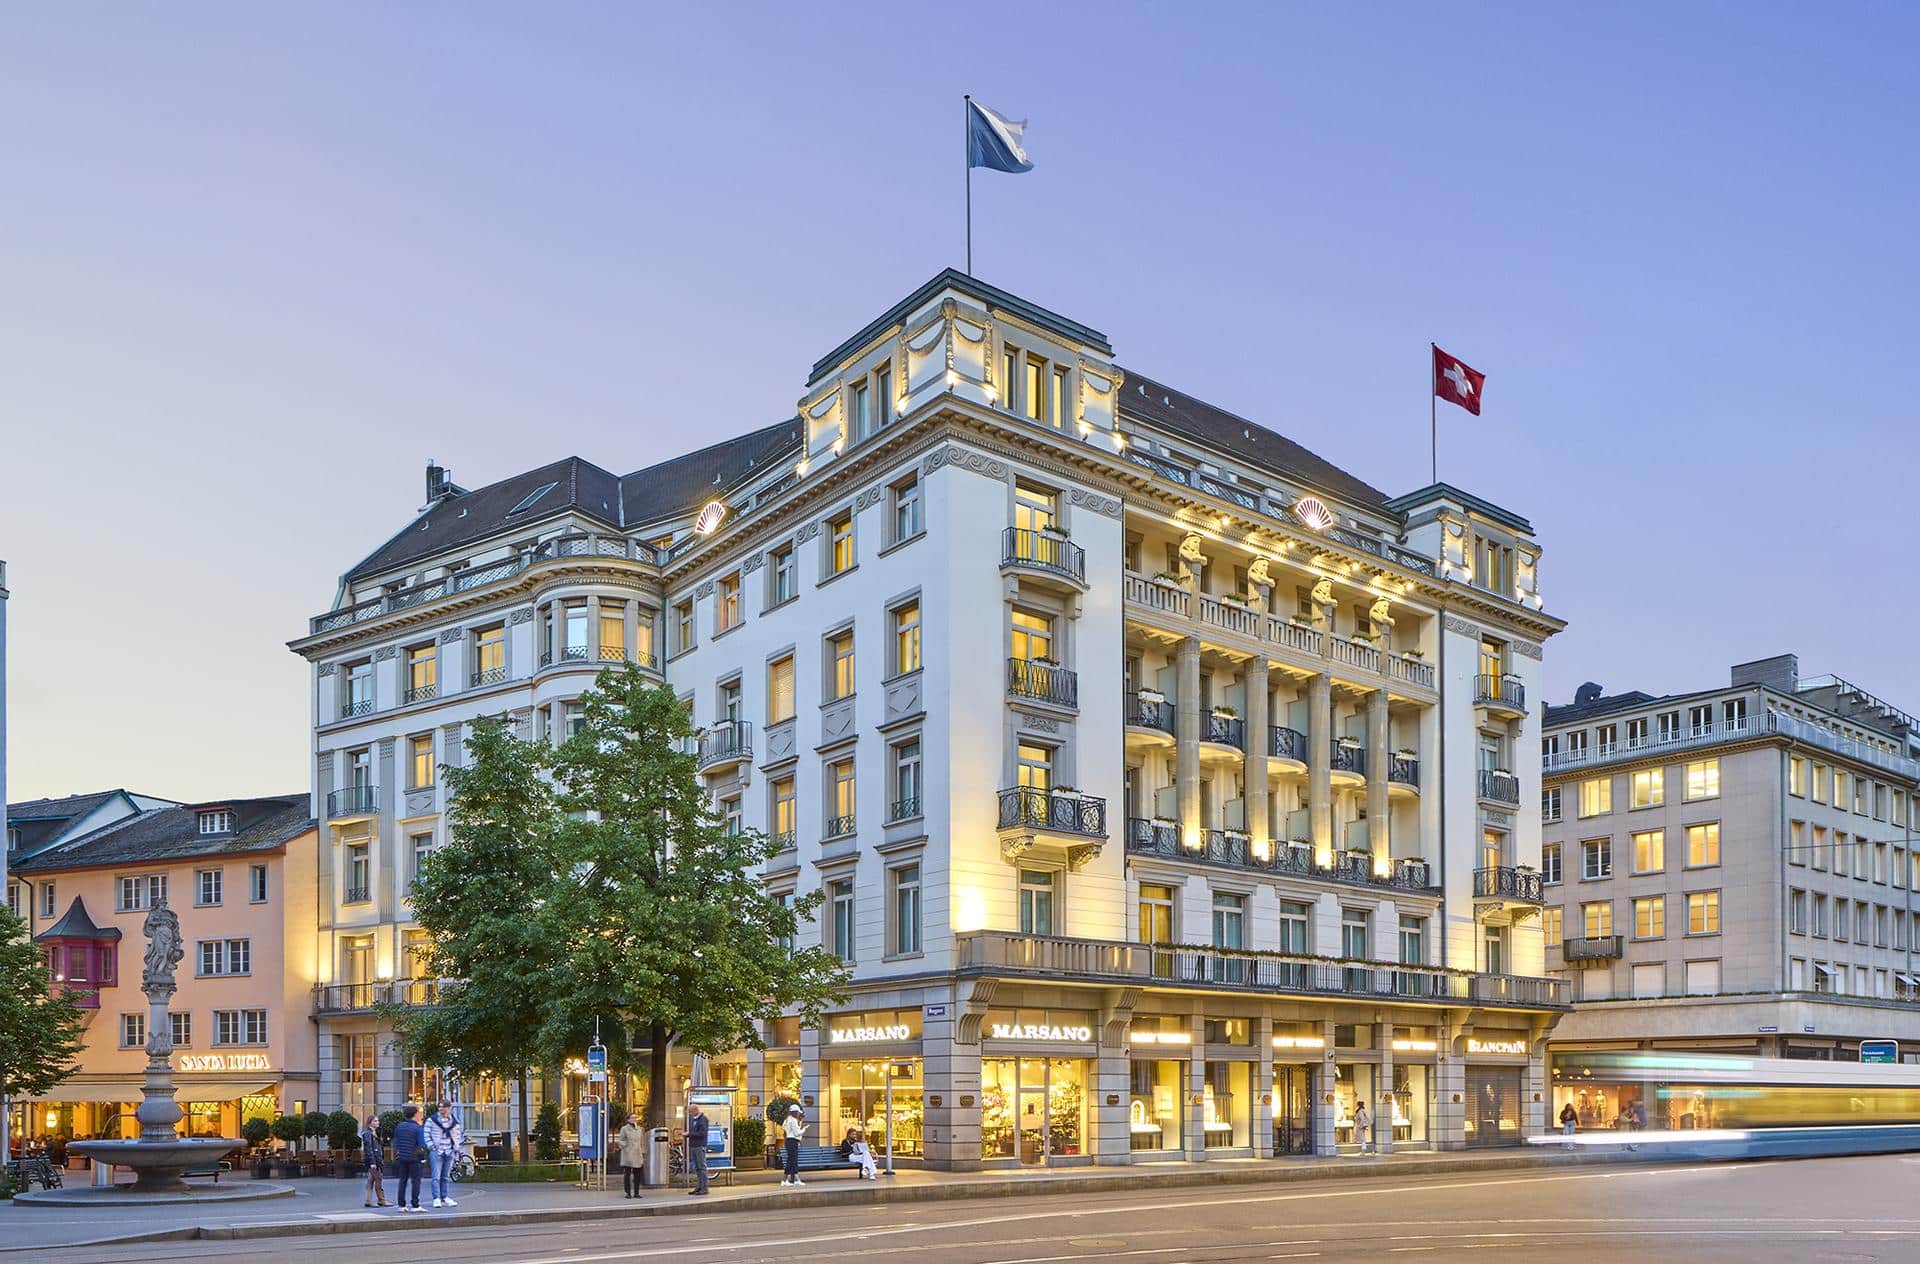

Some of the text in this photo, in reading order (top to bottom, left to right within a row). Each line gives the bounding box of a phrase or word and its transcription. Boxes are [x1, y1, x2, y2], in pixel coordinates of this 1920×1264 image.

[831, 1024, 910, 1042] MARSANO
[992, 1024, 1091, 1041] MARSANO
[181, 1054, 270, 1070] SANTA LUCIA
